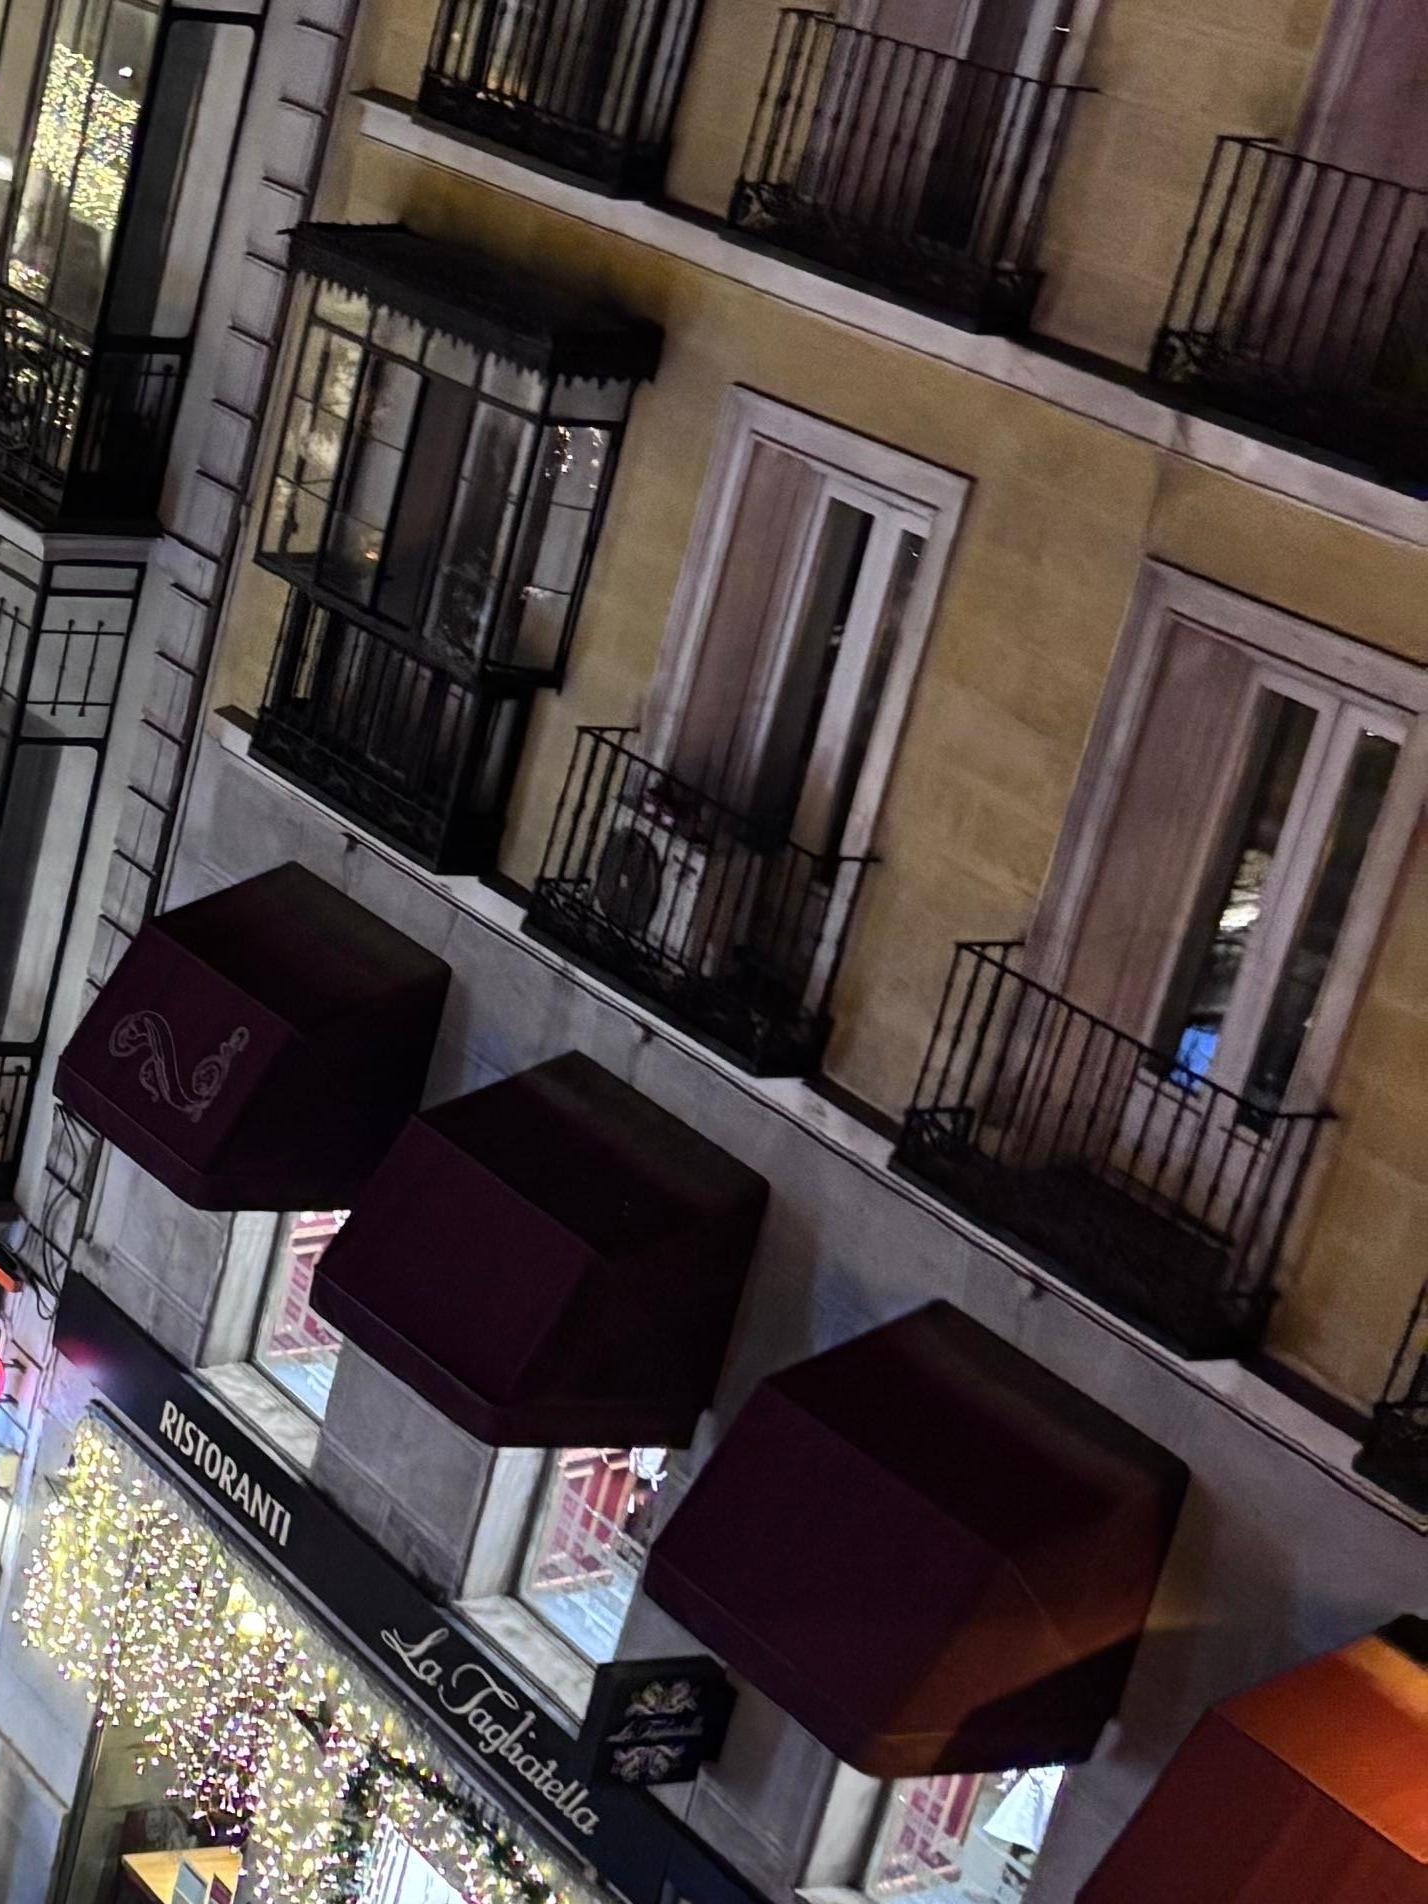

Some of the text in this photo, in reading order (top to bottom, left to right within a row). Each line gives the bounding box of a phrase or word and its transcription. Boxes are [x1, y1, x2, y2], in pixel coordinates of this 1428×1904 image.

[159, 1400, 292, 1547] RISTORANTI
[381, 1627, 600, 1836] La Tagliatella
